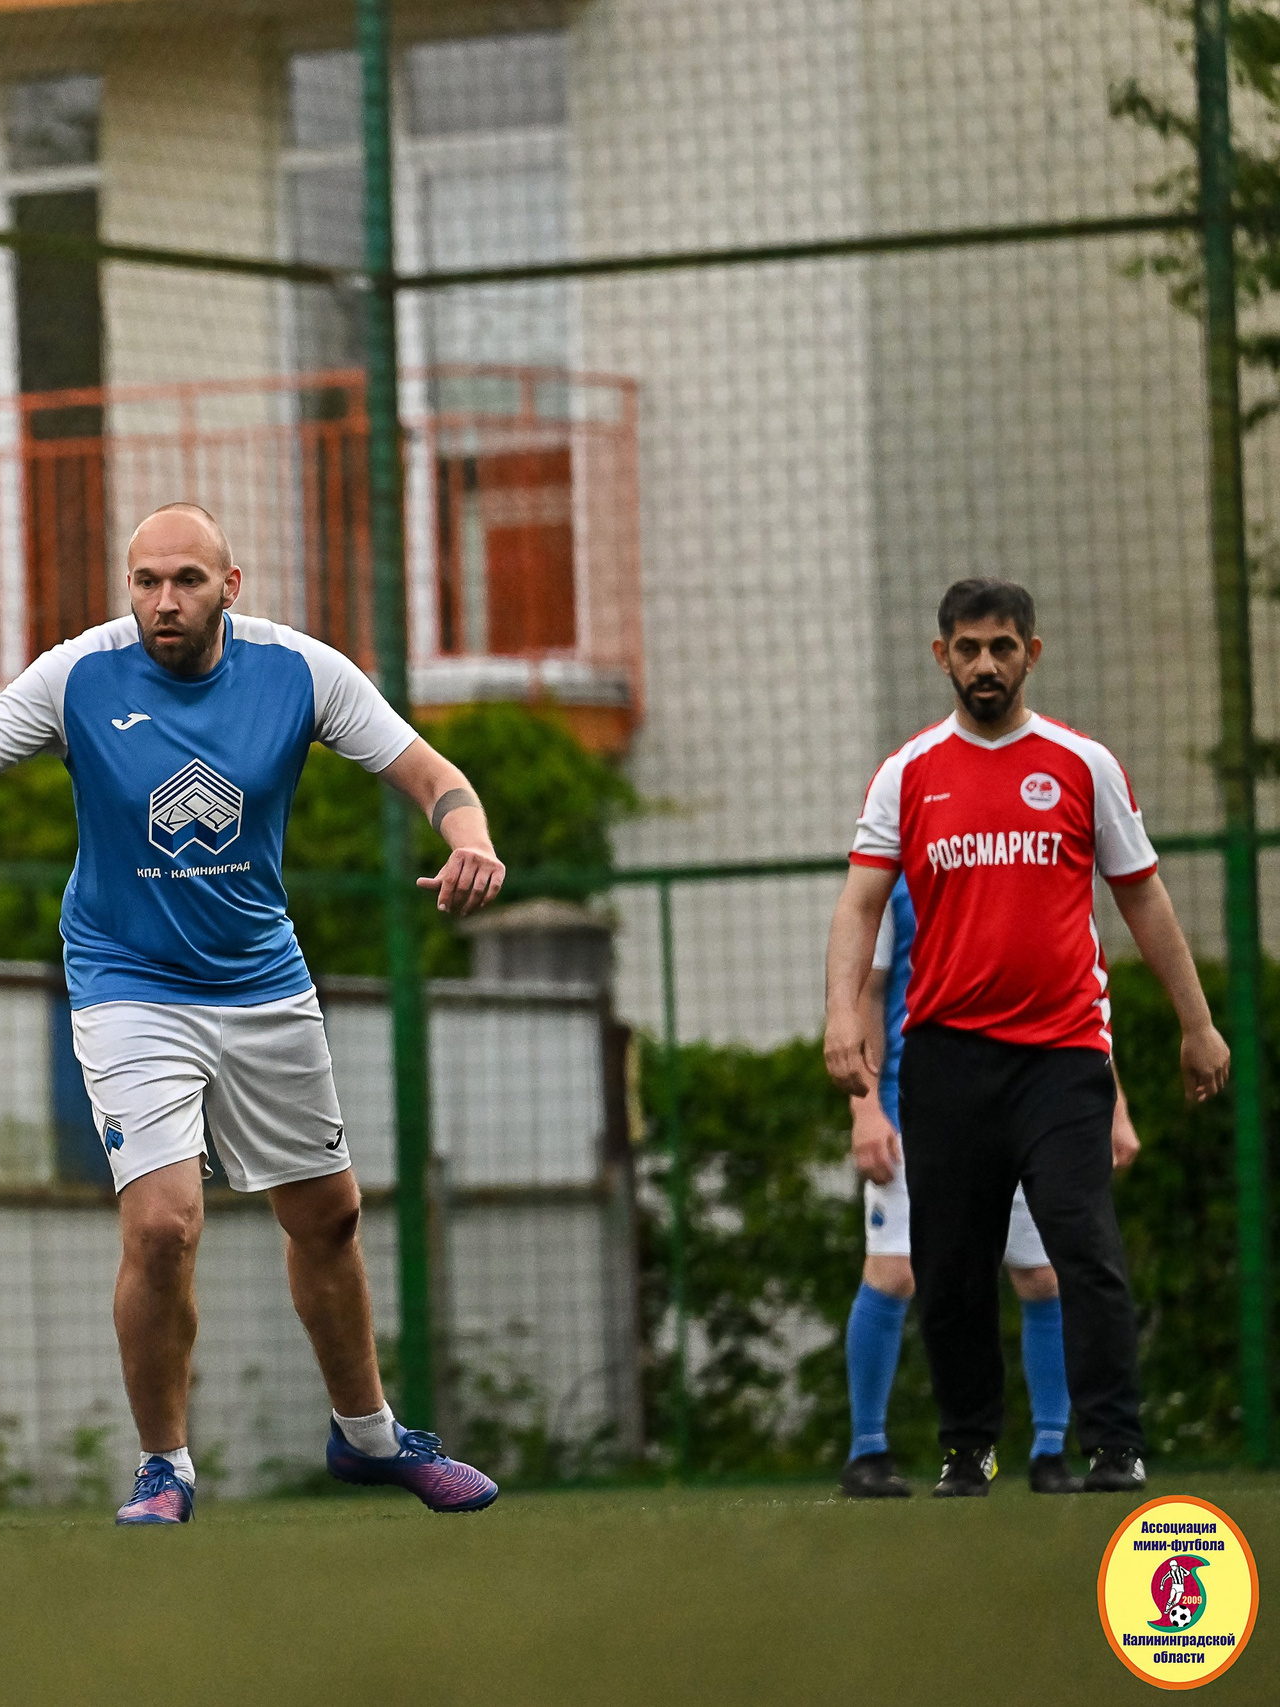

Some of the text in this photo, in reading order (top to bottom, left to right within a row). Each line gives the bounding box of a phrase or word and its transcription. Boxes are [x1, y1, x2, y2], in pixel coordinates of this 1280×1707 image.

[927, 831, 1062, 875] РОССМАРКЕТ
[137, 867, 161, 878] КПД
[171, 860, 251, 879] КАЛИНИНГРАД
